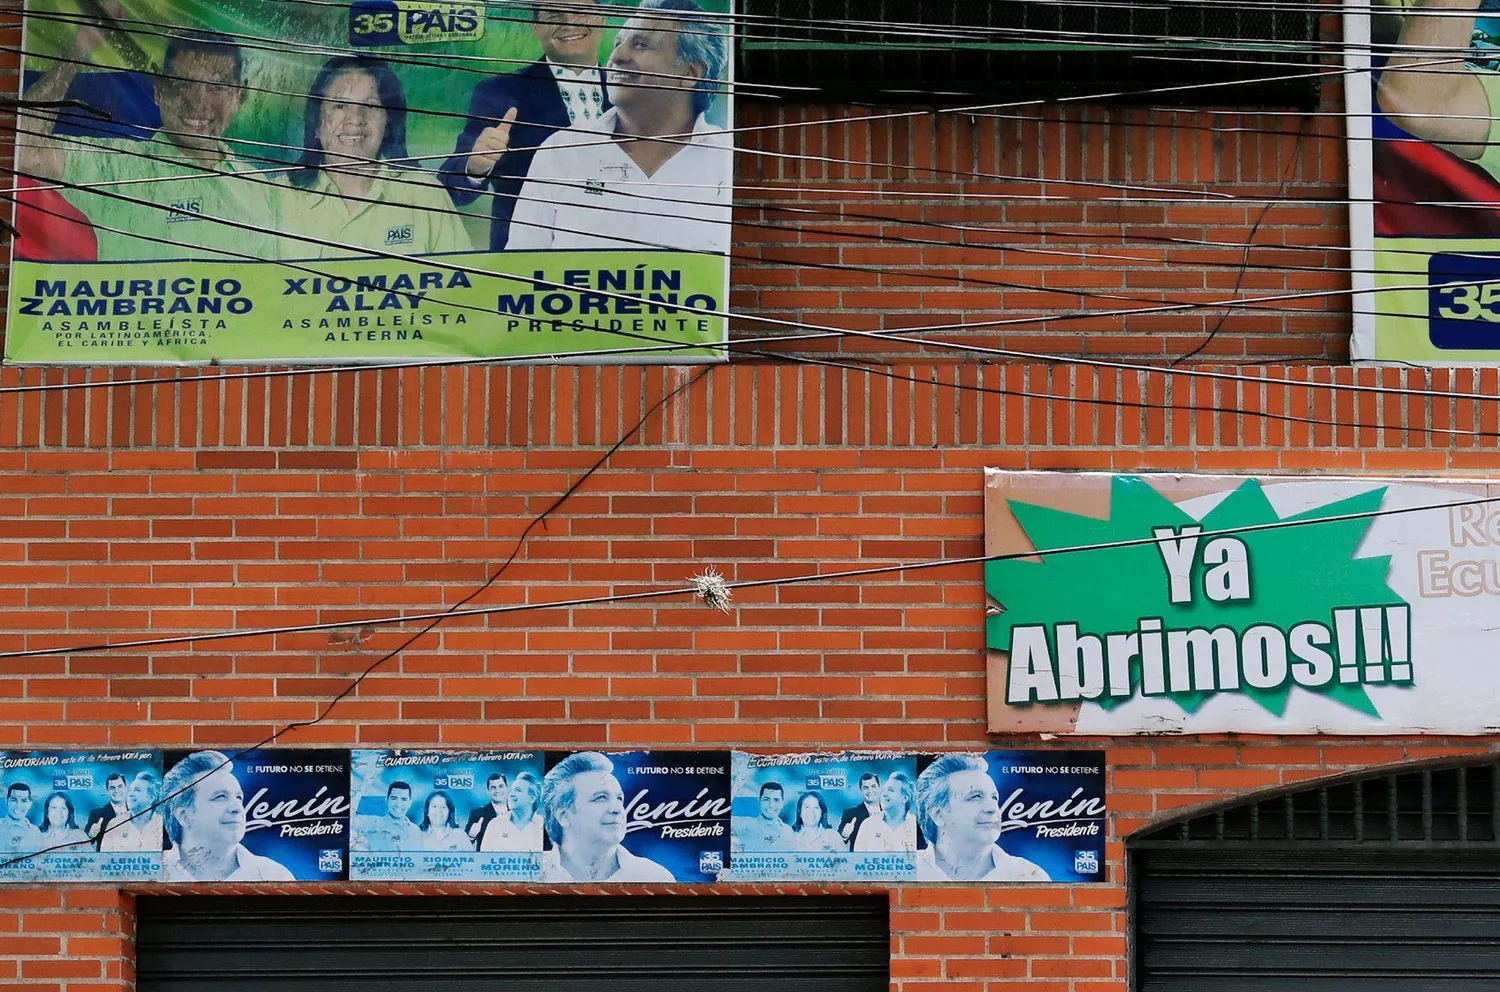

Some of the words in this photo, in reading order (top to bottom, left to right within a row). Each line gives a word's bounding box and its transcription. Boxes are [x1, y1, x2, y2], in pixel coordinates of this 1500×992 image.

[353, 13, 393, 34] 35
[405, 8, 479, 35] PAIS
[282, 271, 472, 295] XIOMARA
[533, 264, 681, 291] LENÍN
[34, 277, 242, 297] MAURICIO
[18, 296, 253, 316] ZAMBRANO
[325, 291, 427, 313] ALAY
[497, 292, 718, 316] MORENO
[42, 317, 227, 331] ASAMBLEÍSTA
[282, 313, 467, 329] ASAMBLEÍSTA
[507, 319, 709, 333] PRESIDENTE
[55, 332, 83, 340] POR
[57, 339, 74, 348] EL
[81, 339, 134, 348] CARIBE
[141, 339, 149, 347] Y
[157, 336, 208, 347] ÁFRICA
[324, 329, 424, 342] ALTERNA
[1152, 524, 1251, 604] Ya
[1005, 603, 1413, 706] Abrimos!!!
[376, 754, 439, 768] ECUATORIANO
[246, 765, 254, 773] EL
[255, 765, 288, 773] FUTURO
[289, 765, 303, 773] NO
[304, 765, 314, 773] SE
[315, 765, 344, 773] DETIENE
[1002, 765, 1009, 773] EL
[1011, 765, 1043, 774] FUTURO
[1045, 766, 1059, 774] NO
[1060, 765, 1069, 774] SE
[1071, 766, 1099, 774] DETIENE
[69, 778, 92, 788] PAIS
[450, 777, 472, 787] PAIS
[822, 777, 845, 787] PAIS
[280, 820, 344, 838] Presidente
[661, 822, 724, 839] Presidente
[1036, 821, 1099, 838] Presidente
[322, 850, 339, 859] 35
[703, 851, 719, 860] 35
[1078, 851, 1095, 859] 35
[320, 861, 341, 870] PAIS
[701, 862, 721, 871] PAIS
[1076, 860, 1097, 870] PAIS
